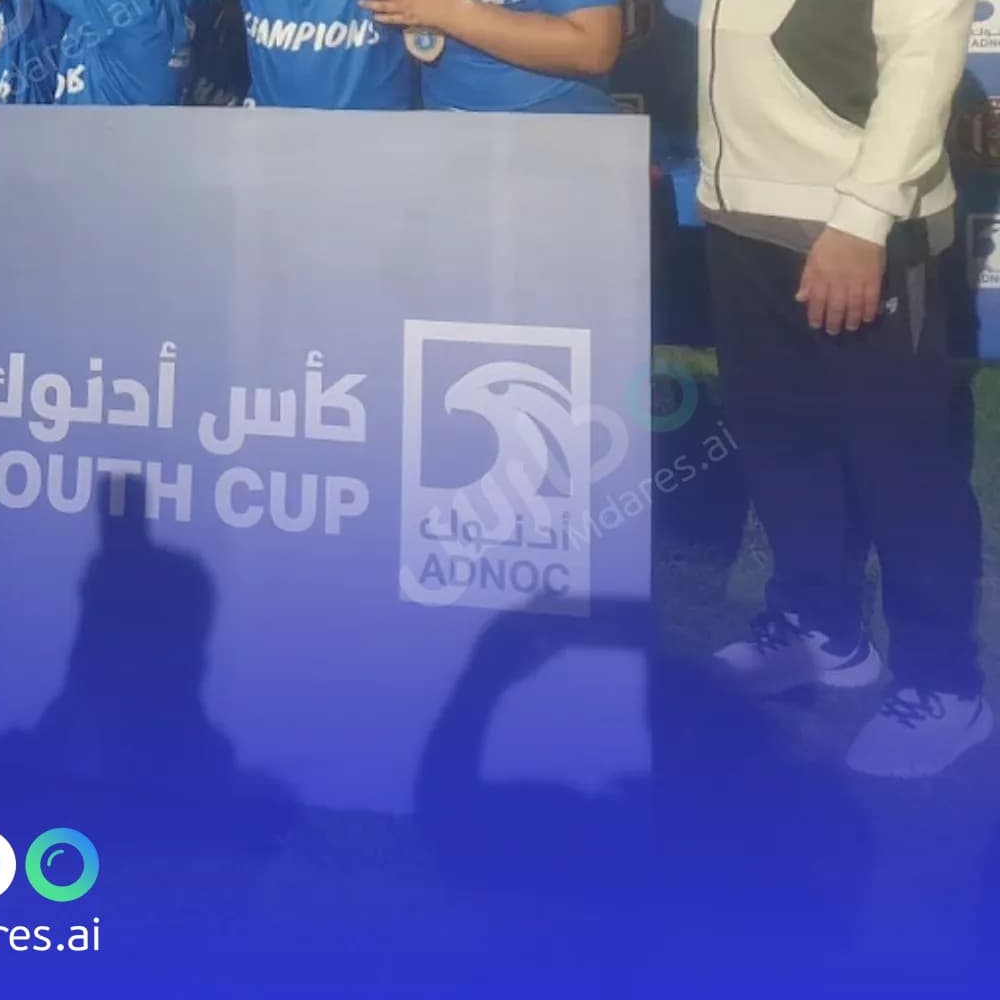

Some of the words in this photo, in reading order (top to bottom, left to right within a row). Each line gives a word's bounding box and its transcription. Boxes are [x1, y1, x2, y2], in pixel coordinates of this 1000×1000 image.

[198, 350, 368, 456] كأس
[213, 466, 370, 535] CUP
[418, 552, 571, 595] ADNOC
